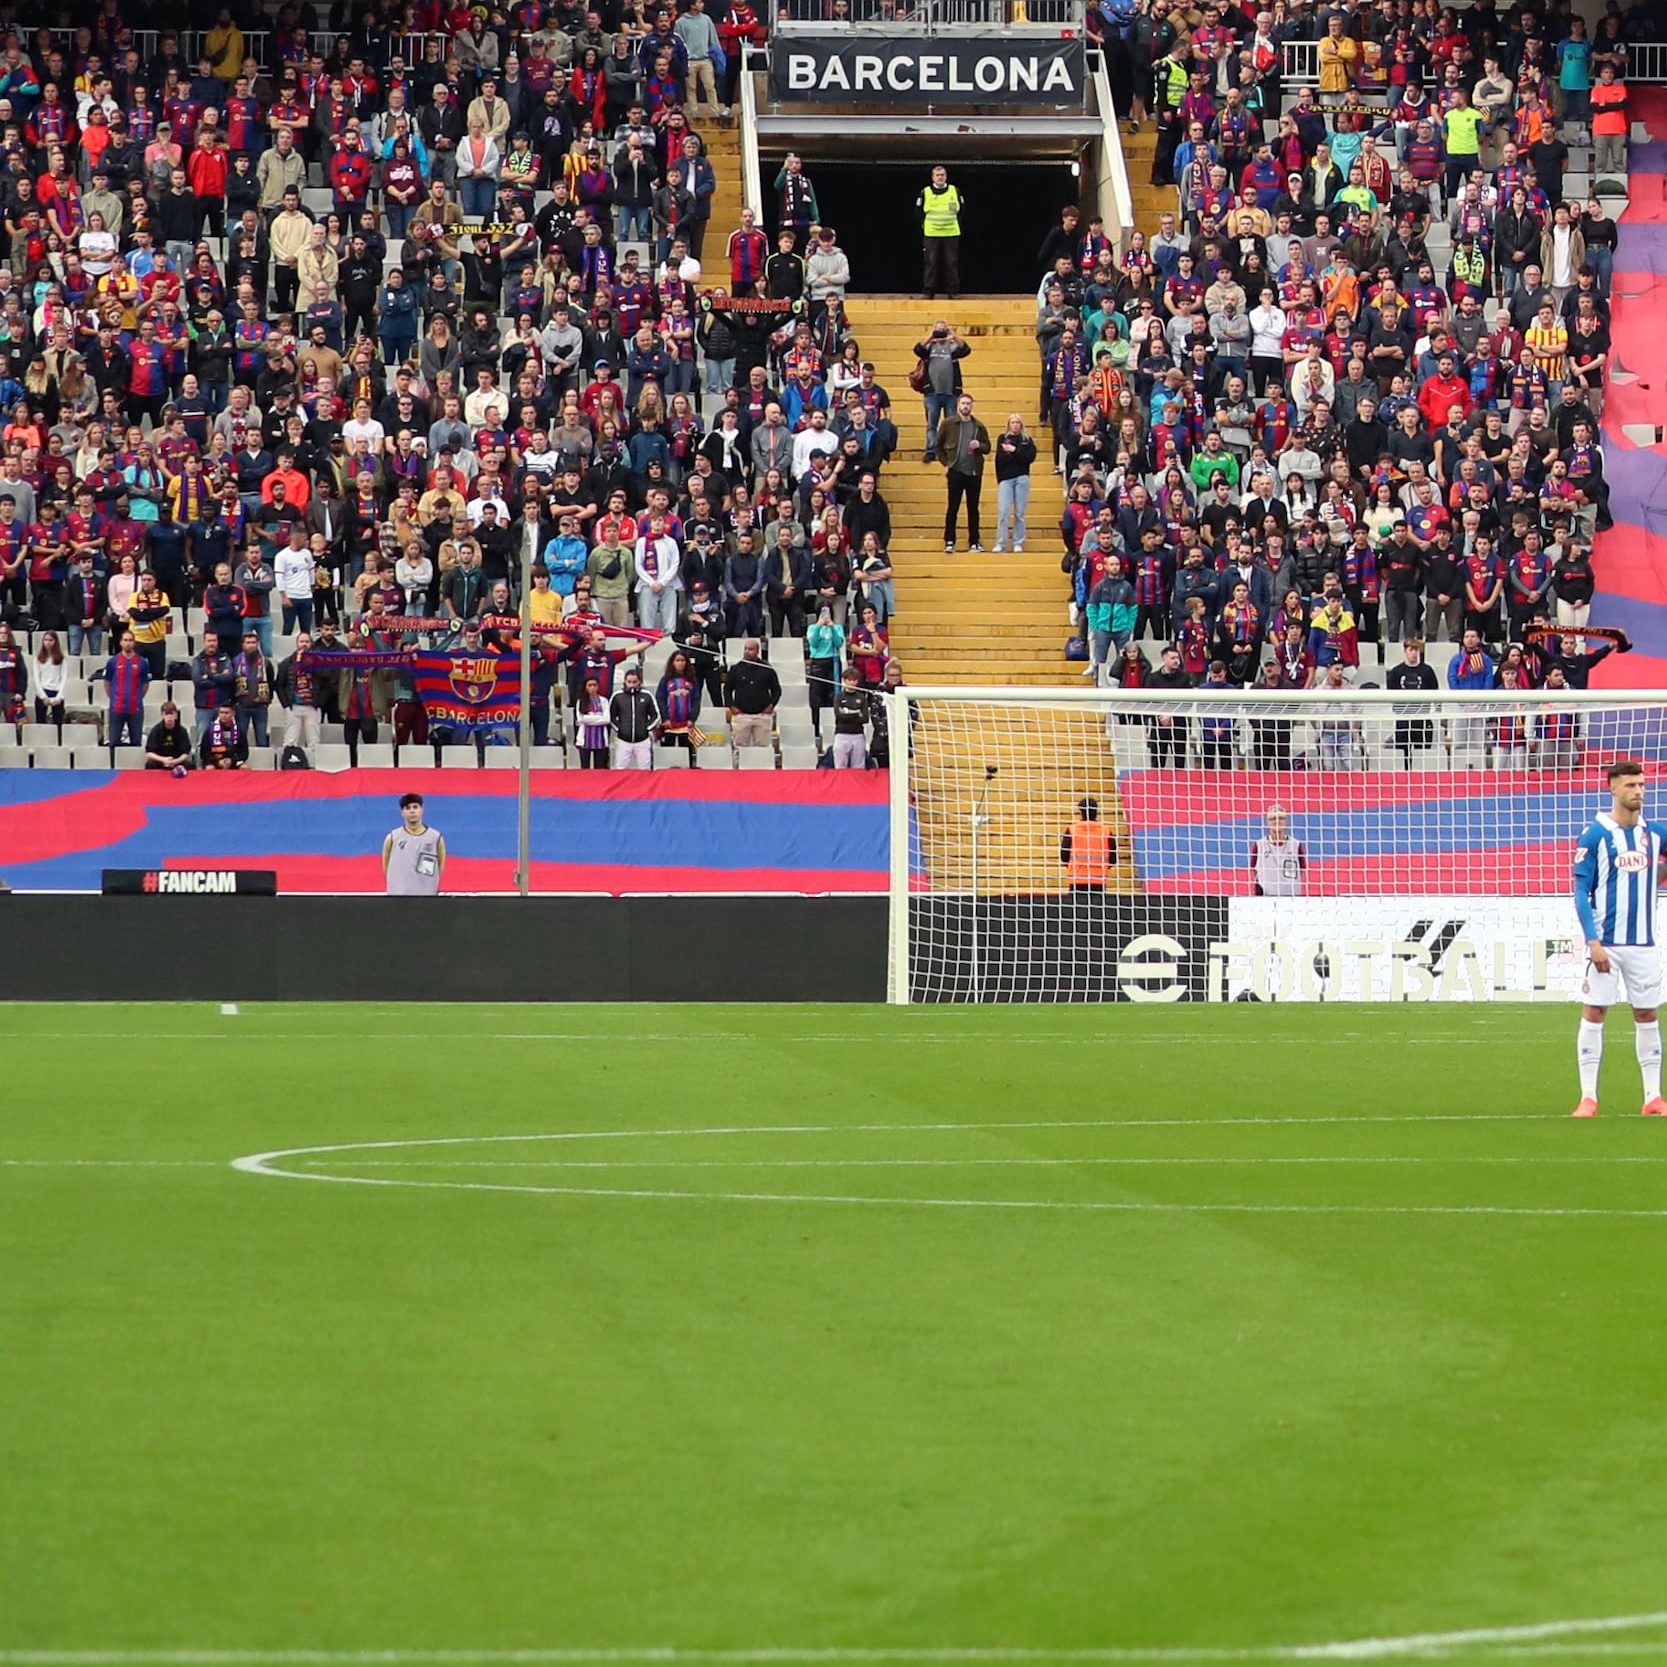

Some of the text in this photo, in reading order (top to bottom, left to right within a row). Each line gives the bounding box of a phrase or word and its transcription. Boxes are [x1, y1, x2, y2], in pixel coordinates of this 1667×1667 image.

[788, 55, 1074, 91] BARCELONA
[1618, 855, 1645, 868] DANI
[142, 871, 237, 894] #FANCAM
